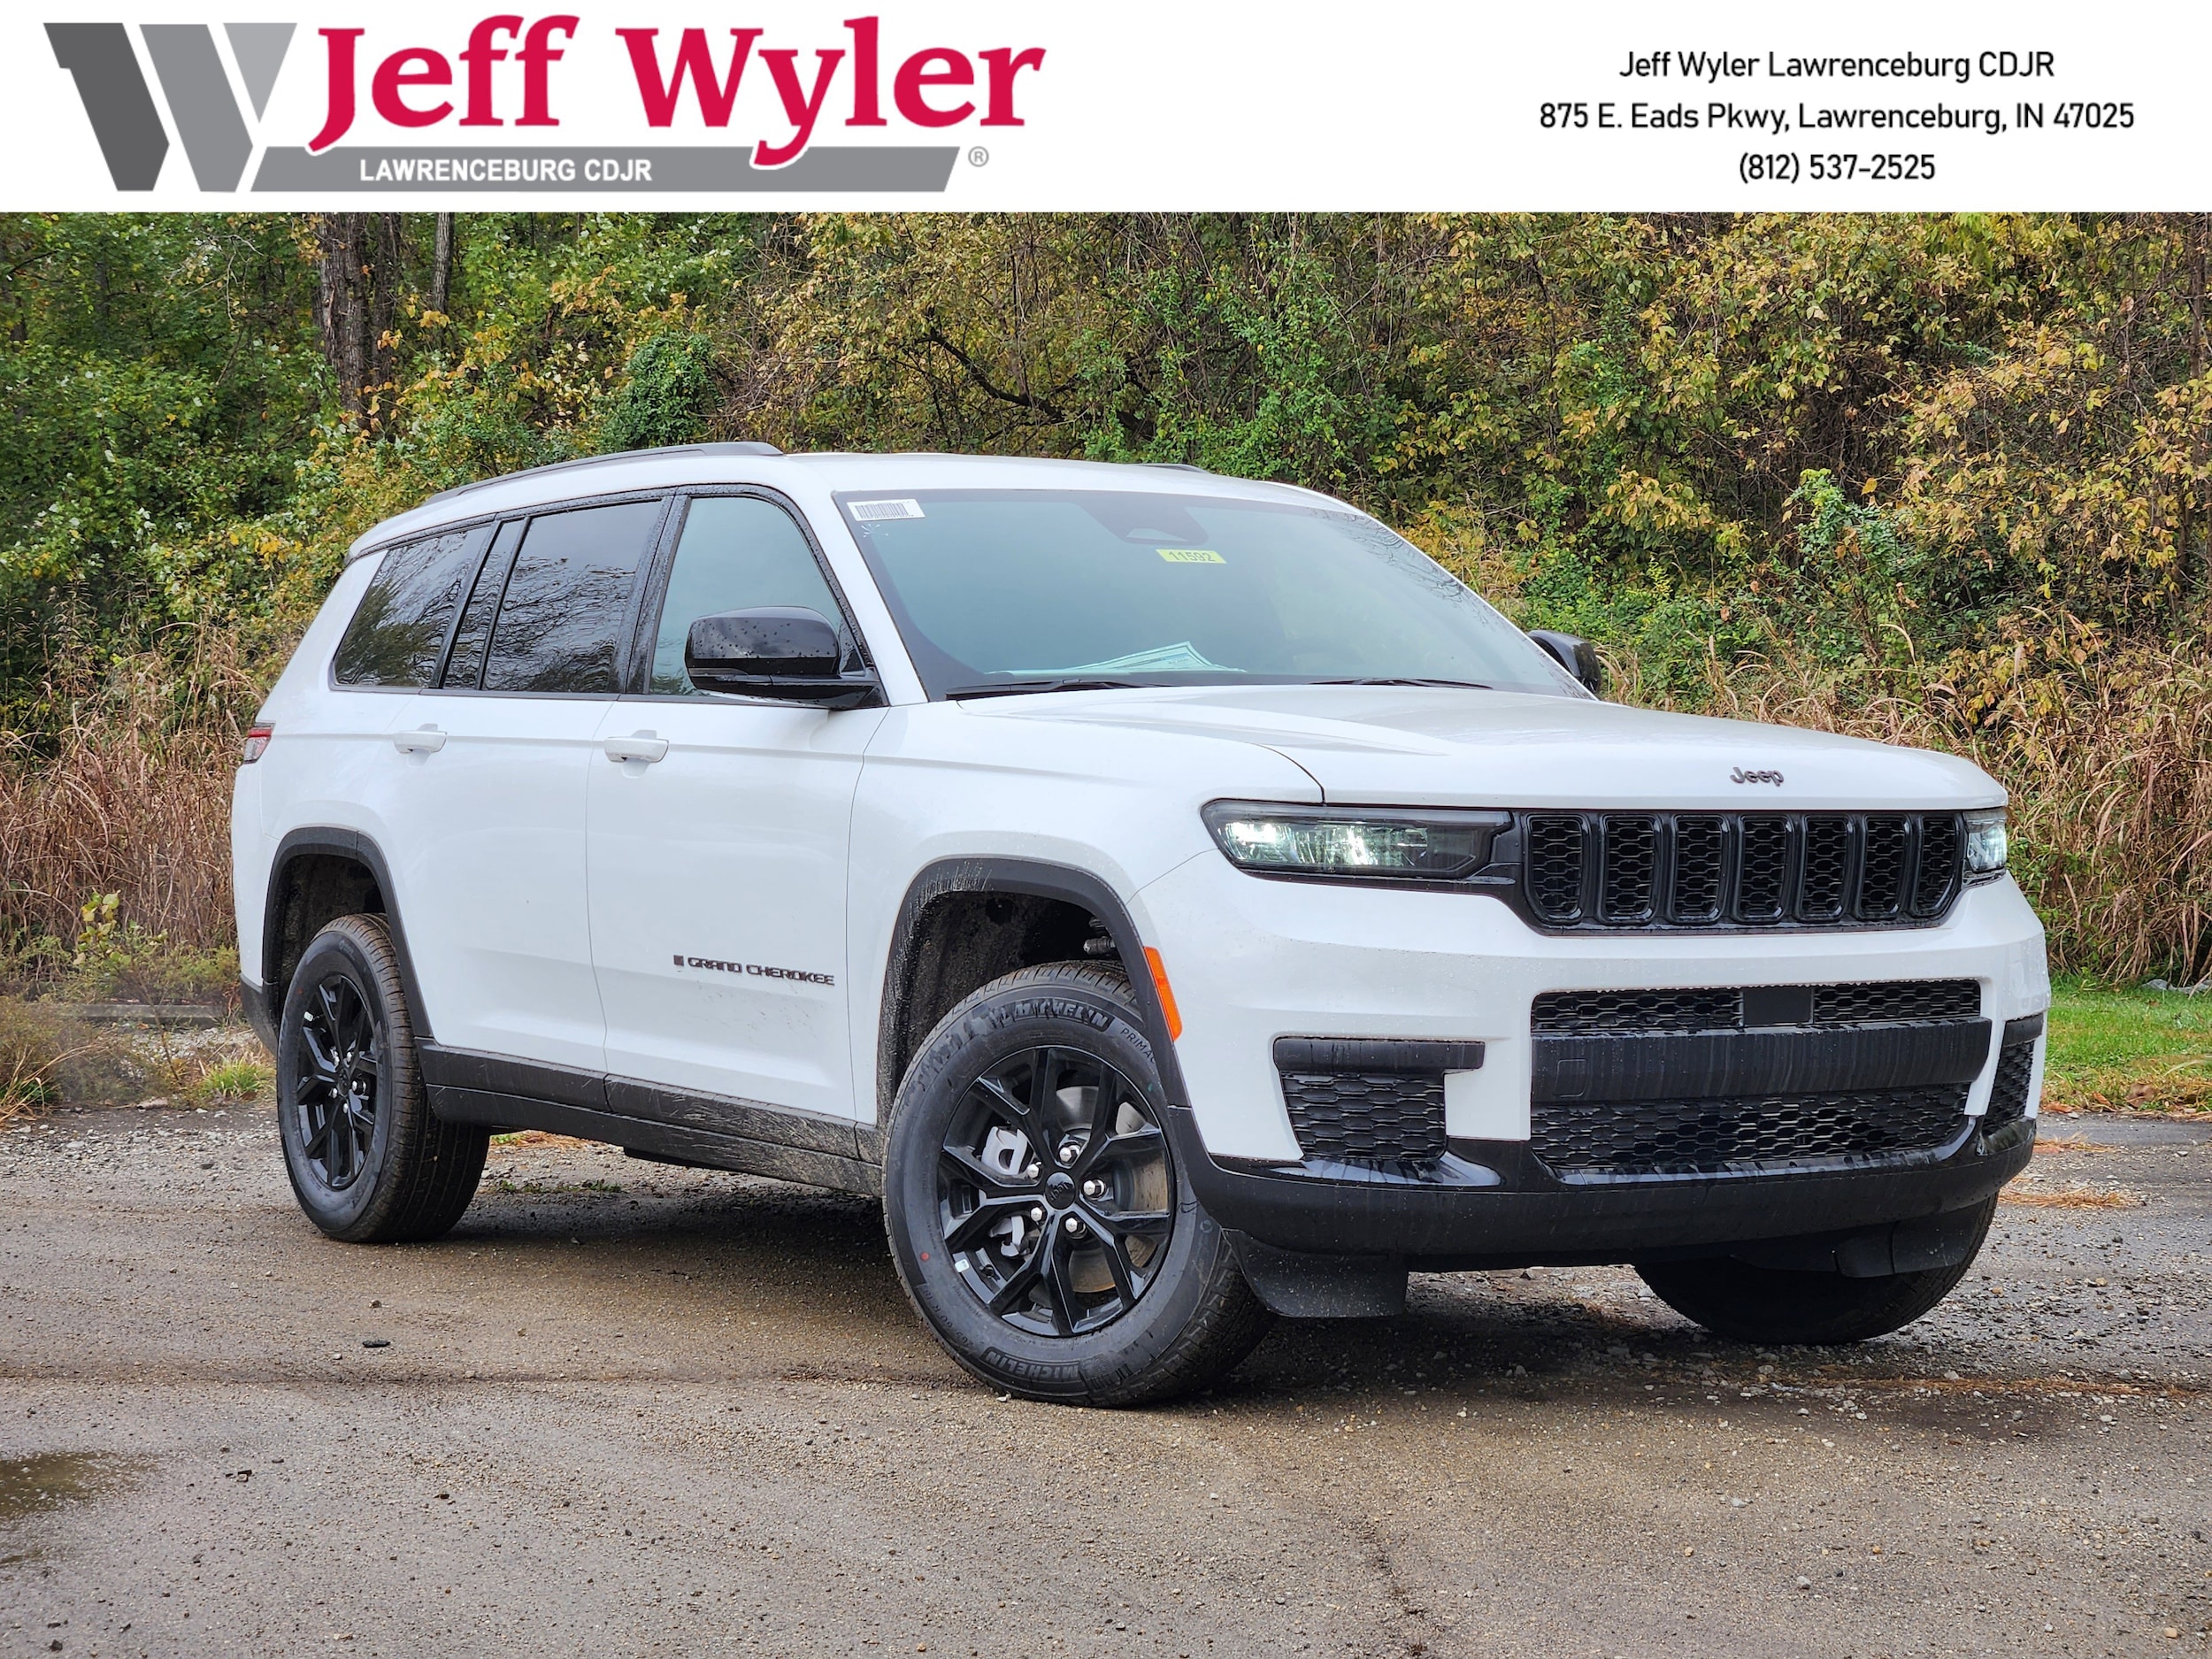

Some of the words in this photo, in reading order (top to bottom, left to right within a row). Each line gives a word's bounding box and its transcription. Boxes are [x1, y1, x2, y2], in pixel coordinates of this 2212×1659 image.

[1169, 550, 1216, 563] 11592
[1730, 766, 1785, 787] Jeep
[687, 956, 742, 974] GRAND
[746, 964, 835, 987] CHEROKEE
[985, 1350, 1079, 1380] MICHELIN
